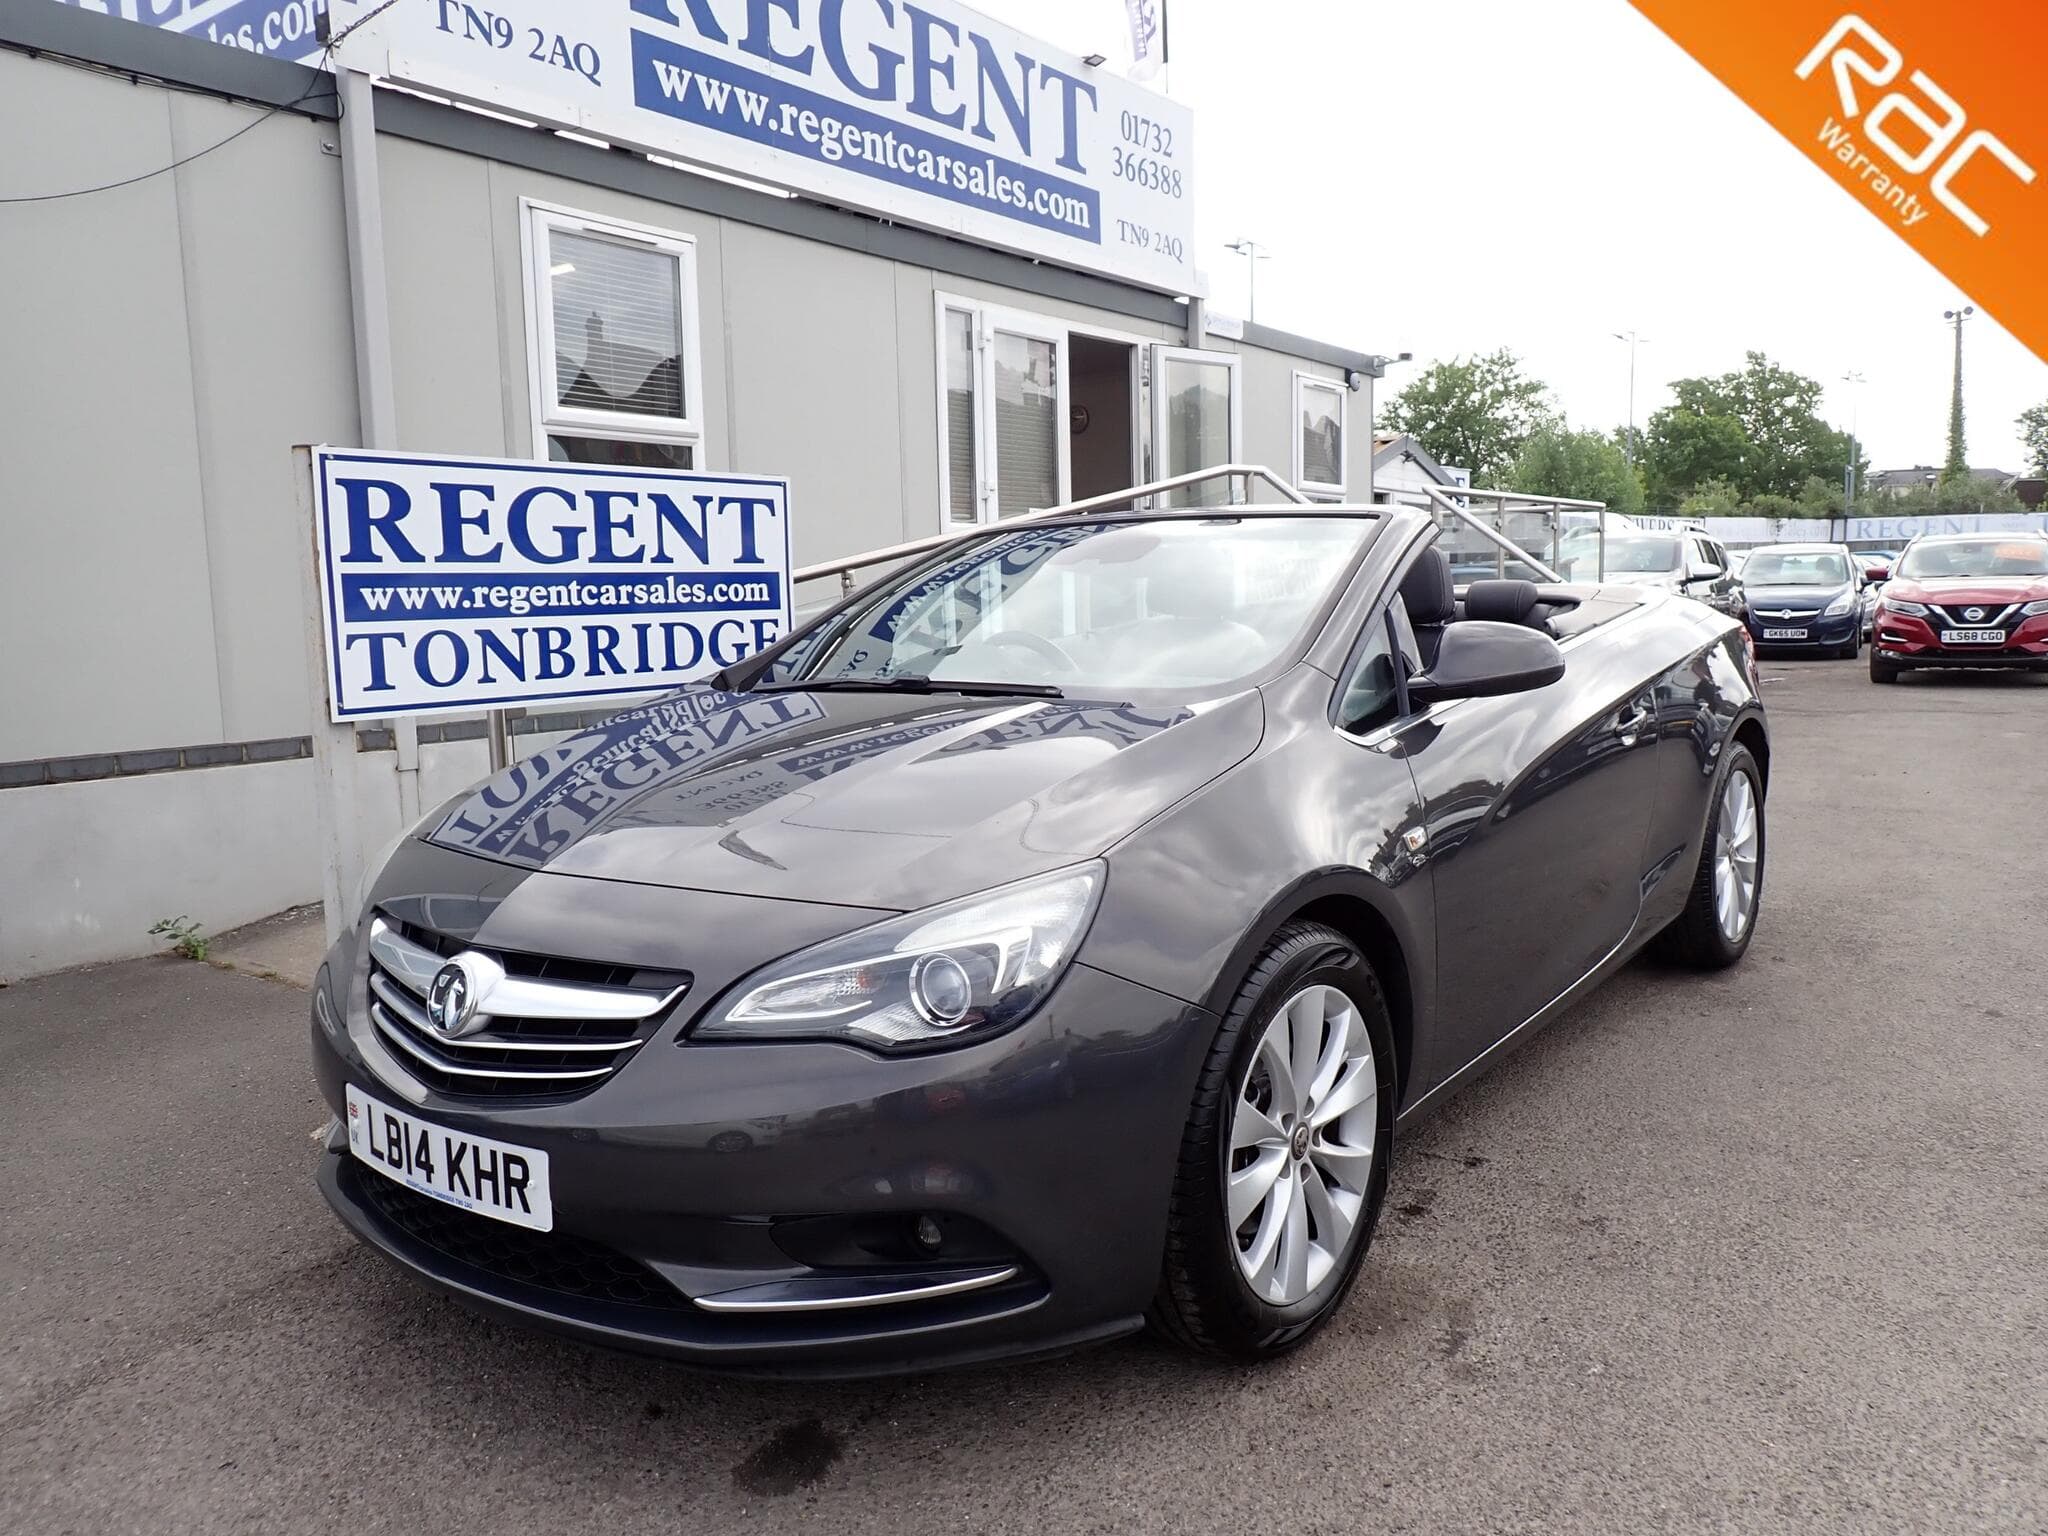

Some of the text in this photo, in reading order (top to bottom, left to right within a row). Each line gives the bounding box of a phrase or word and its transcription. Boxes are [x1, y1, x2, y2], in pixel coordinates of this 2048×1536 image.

[427, 0, 602, 87] TN9 2AQ
[652, 59, 1090, 228] www.regentcarsales.com
[1120, 109, 1173, 158] 01732
[1112, 146, 1182, 199] 366388
[1116, 218, 1183, 264] TN9 2AQ
[335, 478, 776, 565] REGENT
[1855, 514, 1982, 539] REGENT
[360, 576, 770, 615] www.regentcarsales.com
[345, 618, 780, 692] TONBRIDGE
[1949, 631, 2003, 642] LS68 CGO
[367, 1104, 531, 1214] LB14 KHR
